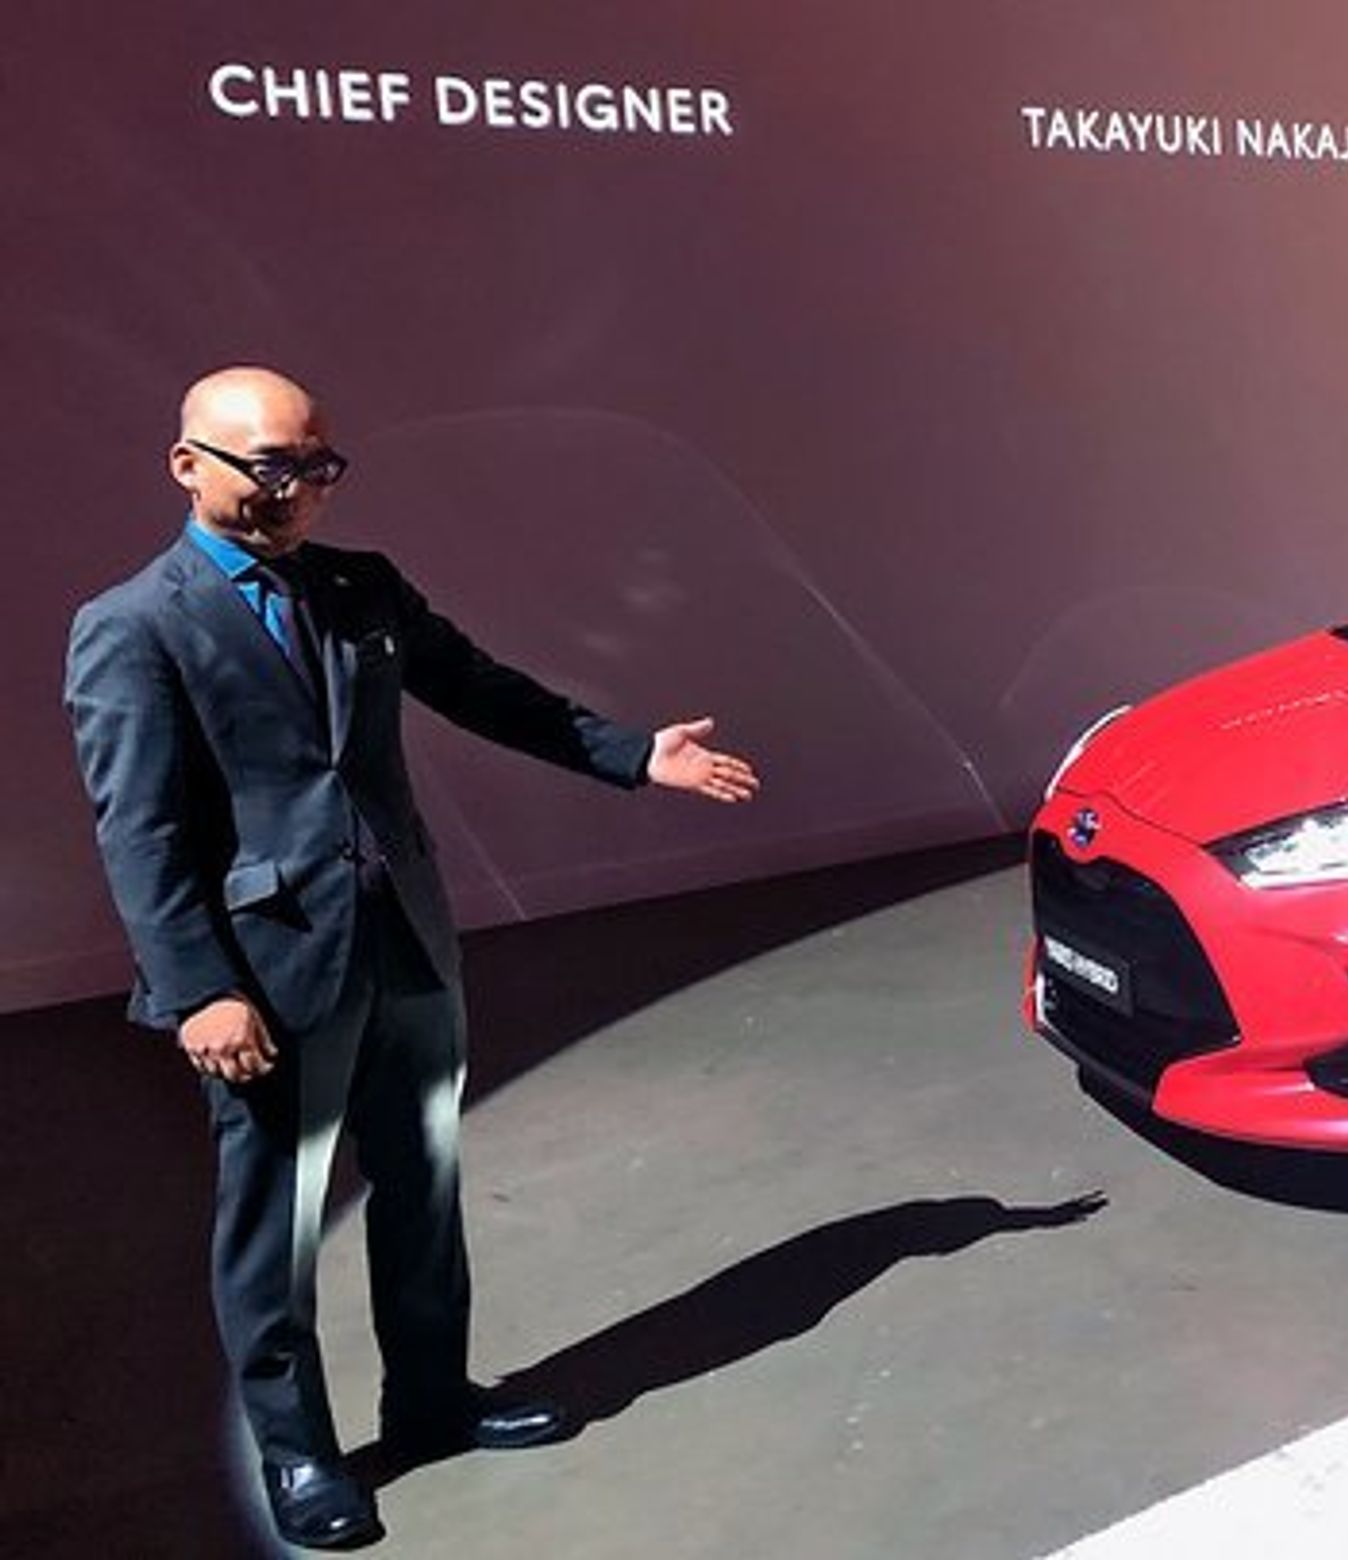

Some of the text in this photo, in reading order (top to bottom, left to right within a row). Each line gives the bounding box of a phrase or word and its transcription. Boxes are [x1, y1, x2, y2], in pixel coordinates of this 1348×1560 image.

[209, 64, 734, 136] CHIEF DESIGNER
[1022, 107, 1221, 156] TAKAYUKI
